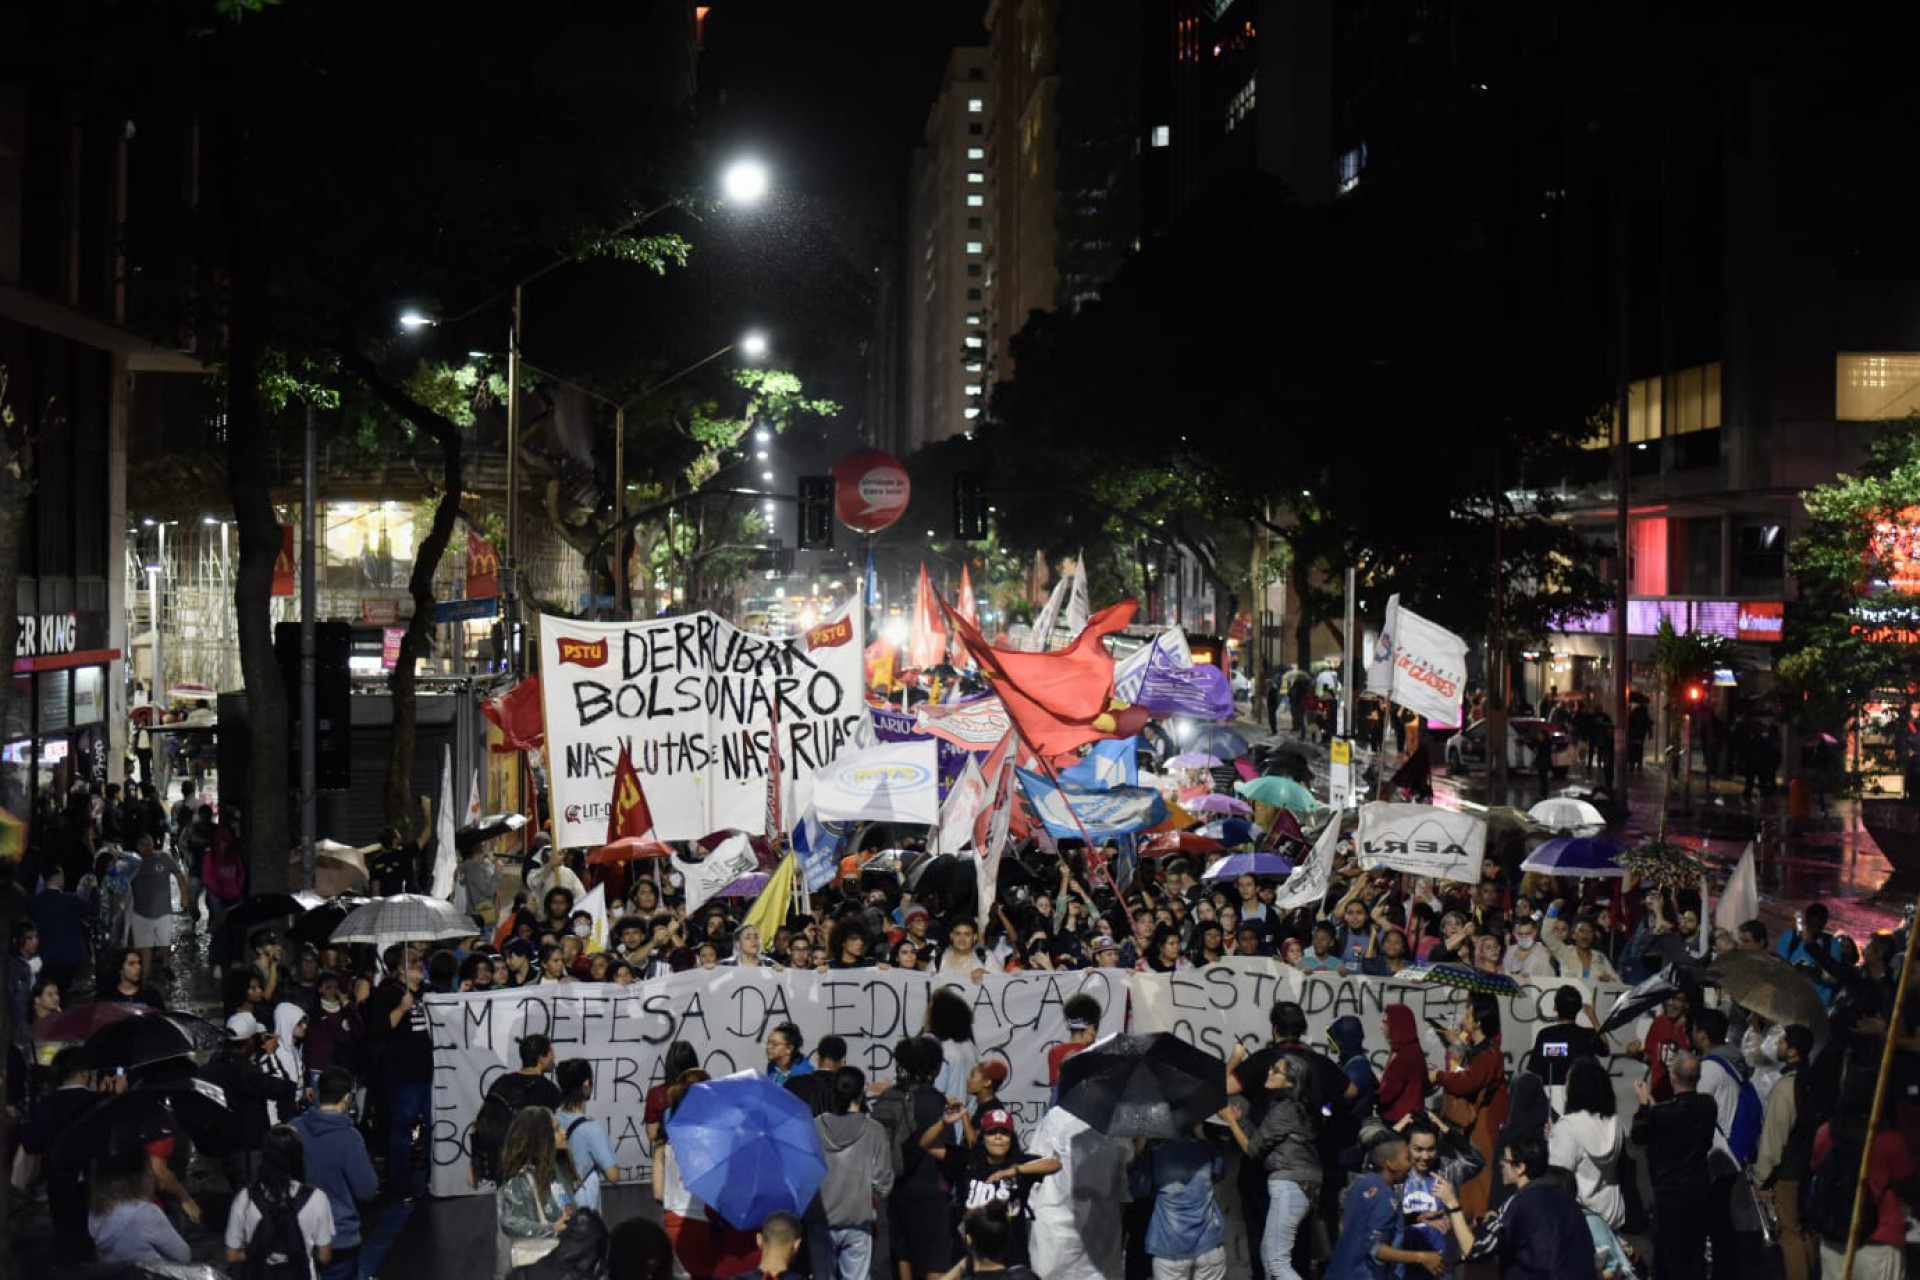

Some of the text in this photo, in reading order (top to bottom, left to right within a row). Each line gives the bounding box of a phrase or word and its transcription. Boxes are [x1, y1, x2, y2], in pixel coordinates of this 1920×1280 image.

[41, 614, 76, 652] KING
[564, 643, 602, 660] PSTU
[622, 614, 818, 681] DERRUBAR
[812, 623, 847, 644] PSTU
[572, 670, 844, 728] BOLSONARO
[426, 999, 492, 1051] EM
[515, 992, 711, 1046] DEFESA
[727, 984, 792, 1044] DA
